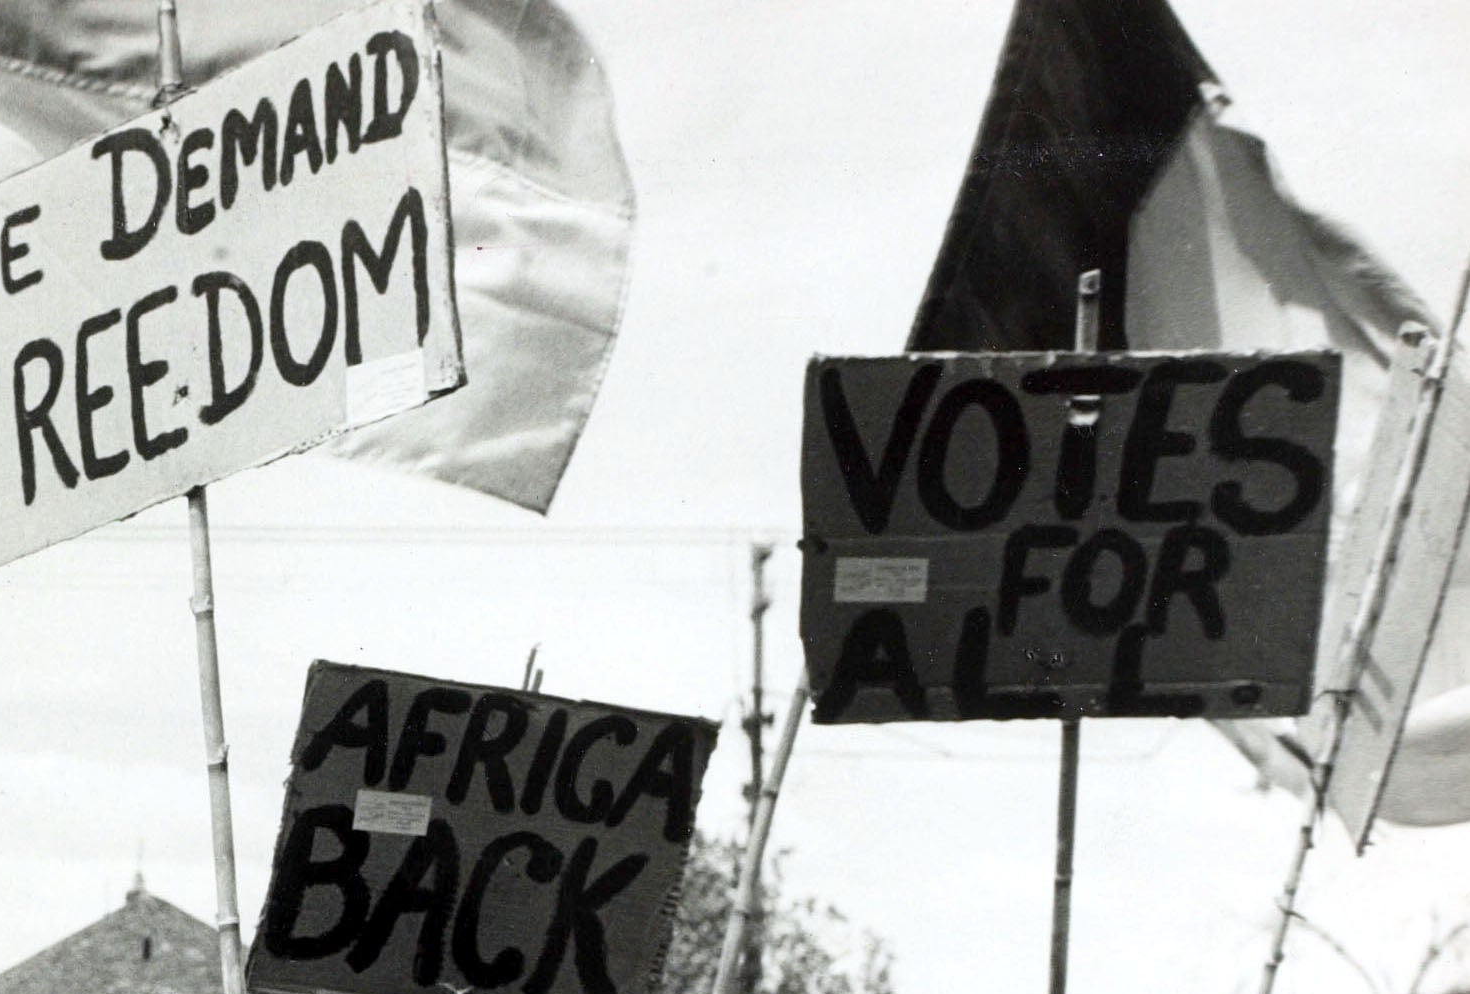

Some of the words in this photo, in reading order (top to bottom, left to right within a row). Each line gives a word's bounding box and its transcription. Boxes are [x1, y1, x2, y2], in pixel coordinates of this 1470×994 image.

[91, 30, 420, 261] DEMAND
[820, 360, 1326, 535] VOTES
[997, 523, 1232, 641] FOR
[301, 679, 696, 843] AFRICA
